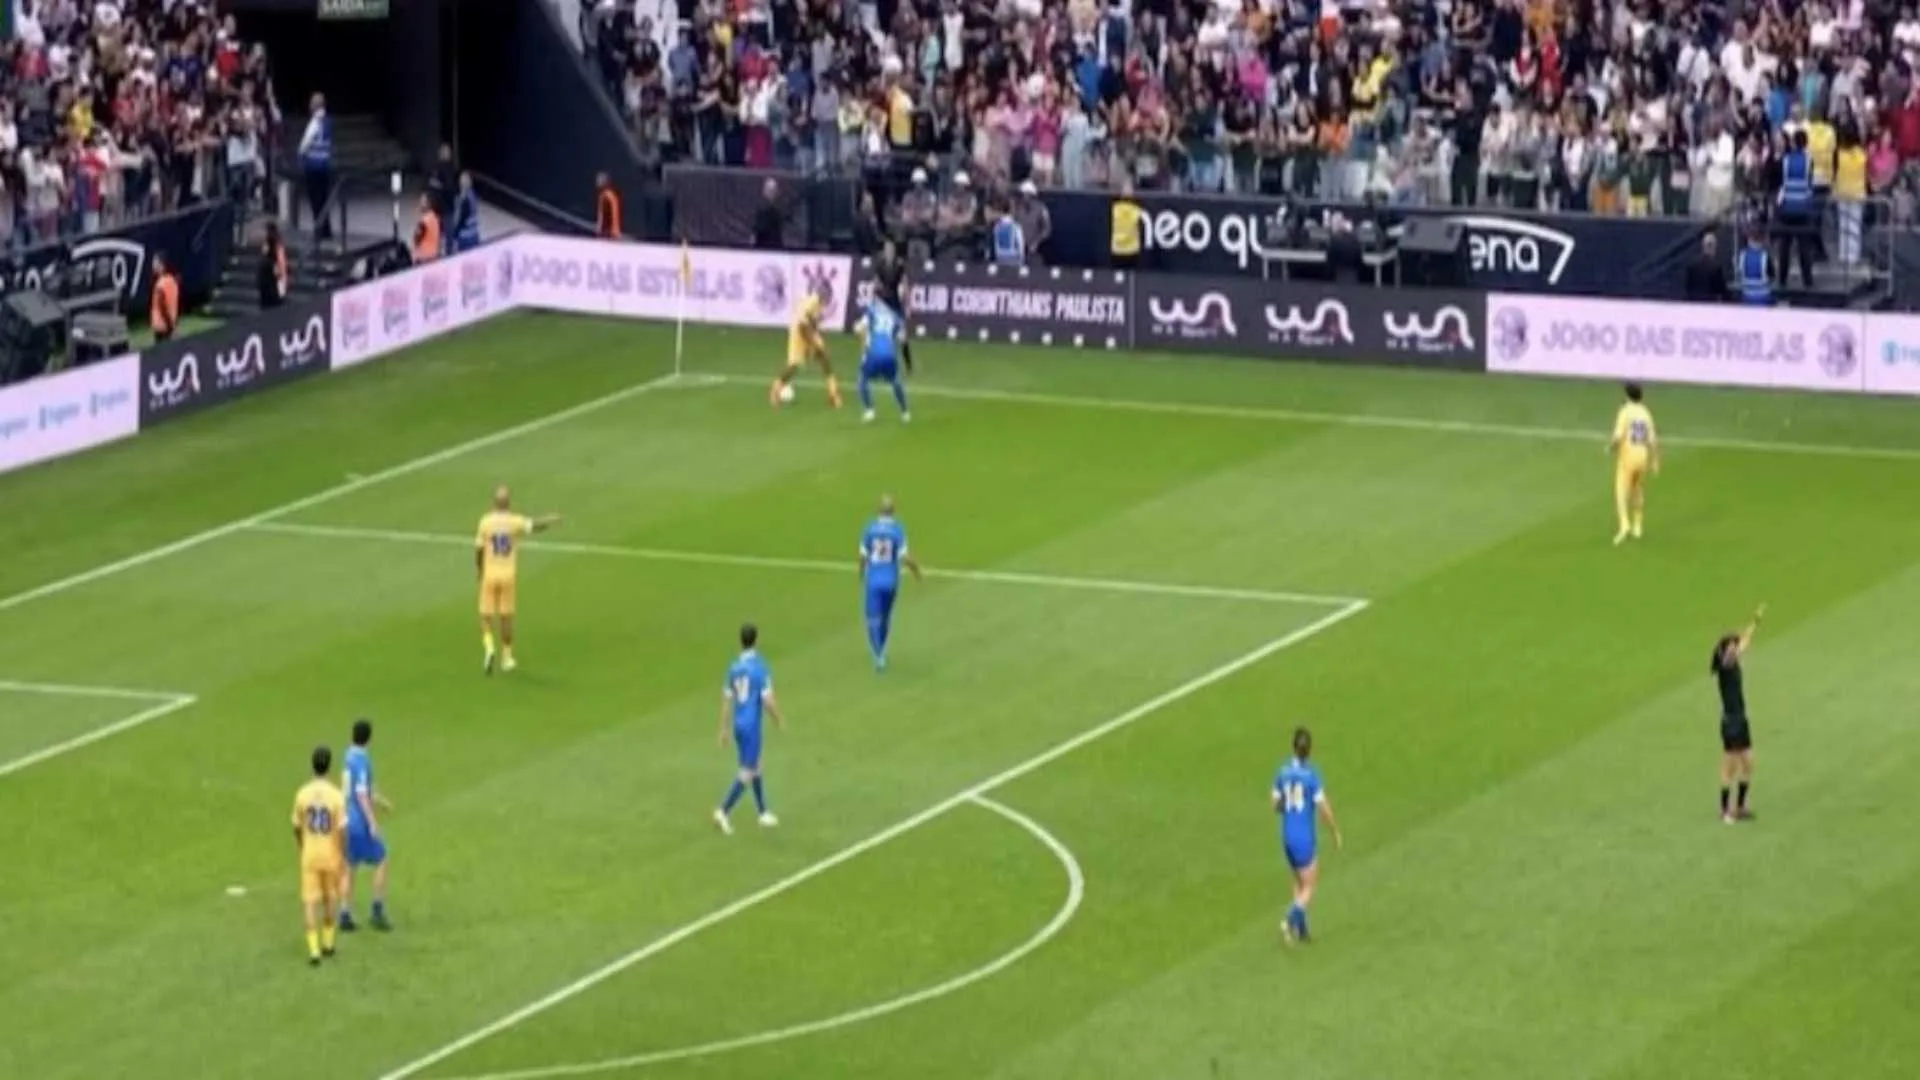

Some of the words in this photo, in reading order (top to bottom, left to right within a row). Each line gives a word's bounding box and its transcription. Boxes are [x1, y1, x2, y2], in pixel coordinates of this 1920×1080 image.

[518, 254, 582, 287] JOGO
[587, 260, 632, 293] DAS
[1541, 319, 1619, 354] JOGO
[1624, 323, 1677, 357] DAS
[1283, 780, 1304, 813] 14
